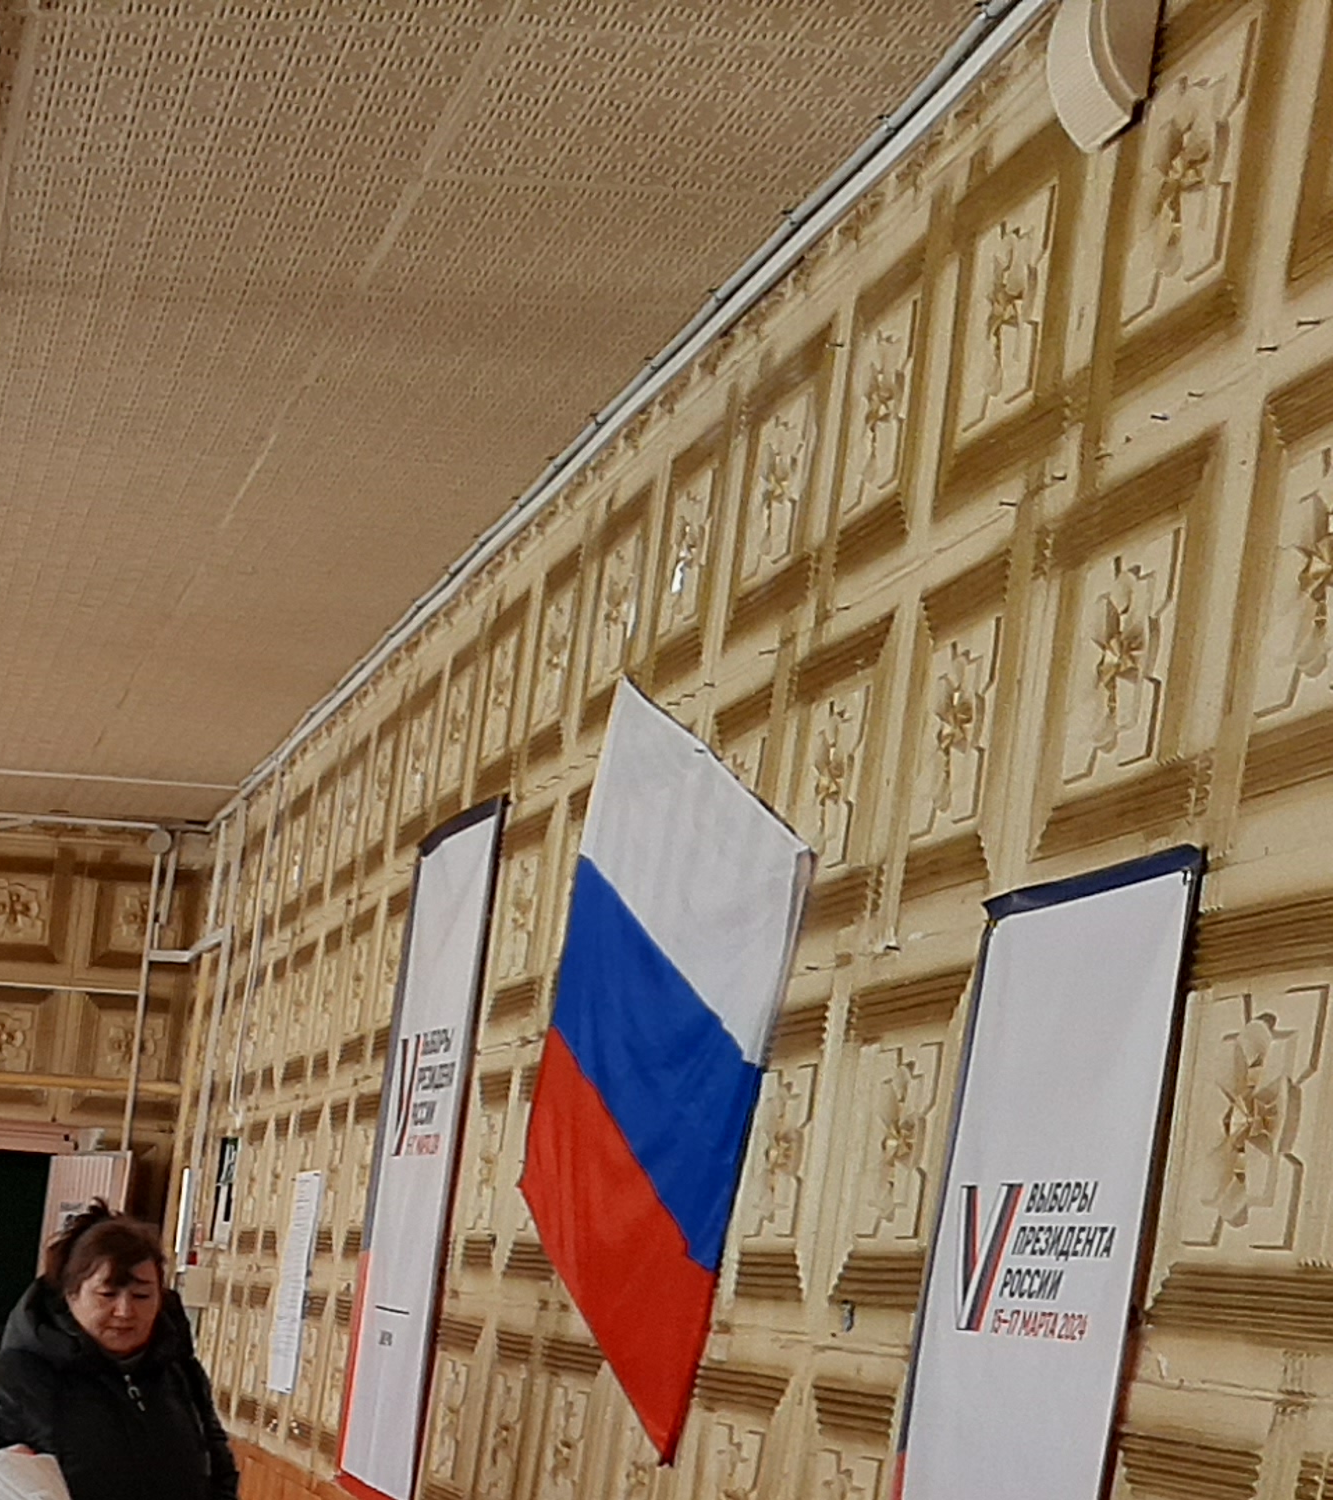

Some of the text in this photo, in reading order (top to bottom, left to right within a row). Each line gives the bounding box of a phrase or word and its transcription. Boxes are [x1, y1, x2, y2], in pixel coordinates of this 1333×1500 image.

[1025, 1181, 1099, 1213] ВЫБОРЫ
[1011, 1226, 1117, 1262] ПРЕЗИДЕНТА
[999, 1268, 1064, 1300] РОССИИ
[1018, 1310, 1058, 1338] МАРТА
[1057, 1312, 1089, 1341] 2024
